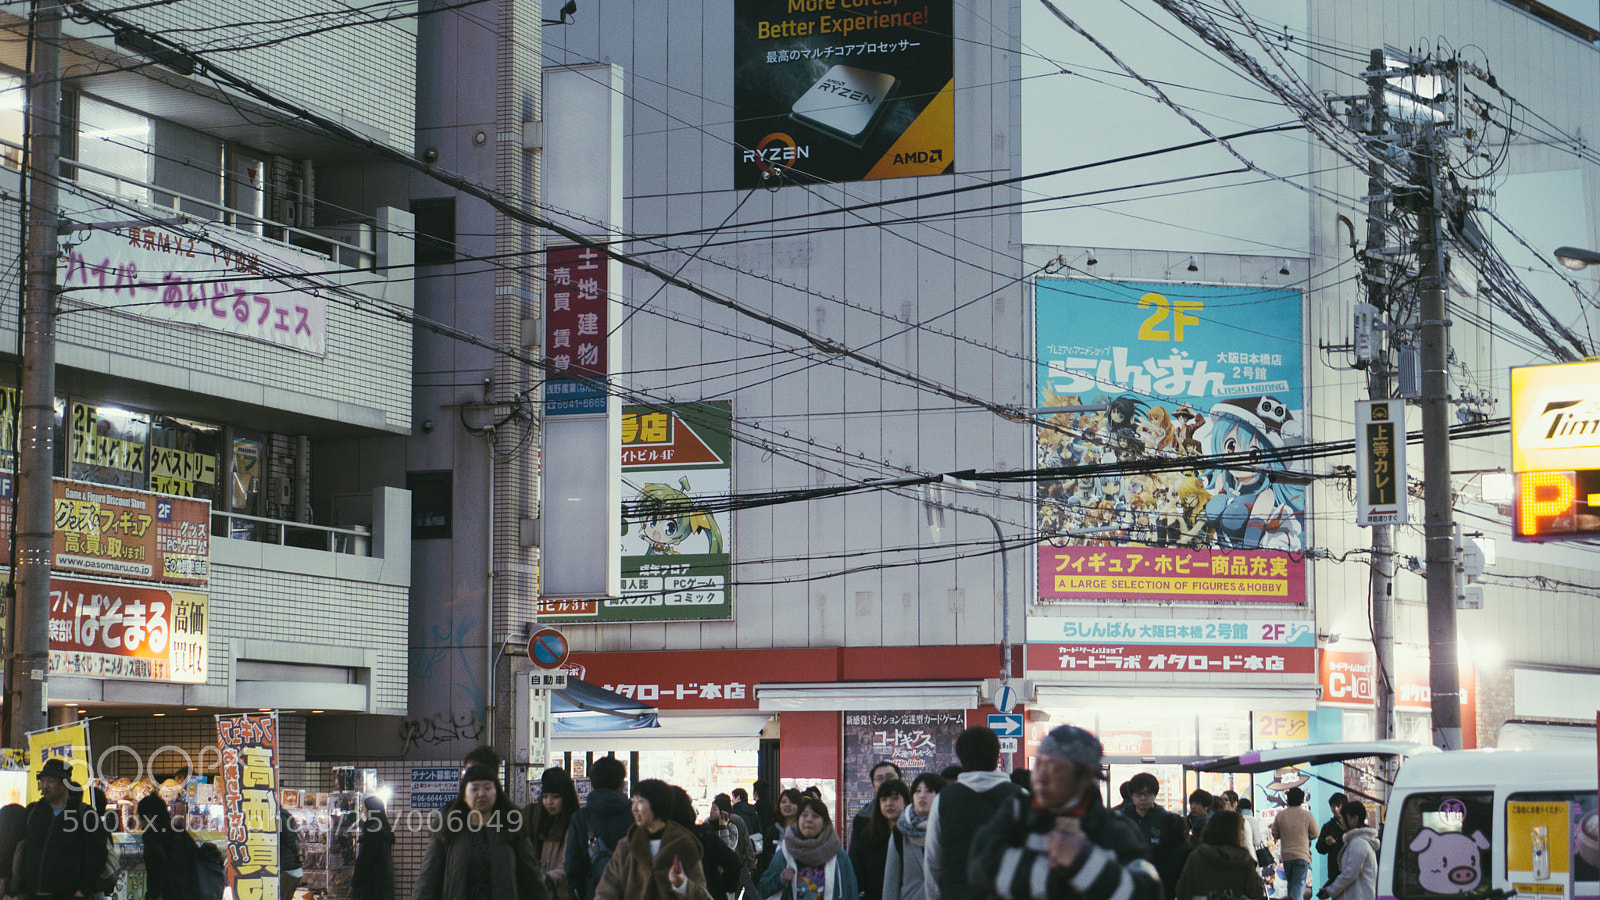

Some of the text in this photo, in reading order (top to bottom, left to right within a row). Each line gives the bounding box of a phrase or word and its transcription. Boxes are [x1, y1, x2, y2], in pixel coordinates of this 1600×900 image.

[788, 0, 835, 14] More
[758, 6, 928, 40] Better Experience!
[766, 39, 921, 64] 最高のマルチコアプロセッサー
[818, 82, 876, 104] RYZEN
[743, 145, 809, 163] RYZEN
[893, 151, 928, 165] AMD
[65, 250, 312, 337] ハイパーあいどるフェス
[553, 267, 571, 312] 売買
[578, 247, 599, 366] 土地建物
[1138, 293, 1203, 341] 2F
[1216, 351, 1282, 367] 大阪日本橋店
[1048, 347, 1226, 397] らしんばん
[1232, 367, 1267, 380] 2号館
[74, 404, 97, 434] 2F
[151, 446, 216, 484] タペストリー
[1372, 424, 1389, 504] 上等カレー
[65, 487, 81, 500] Game
[87, 492, 106, 505] Figure
[106, 494, 131, 508] Discount
[131, 499, 146, 510] Store
[1521, 472, 1574, 536] P
[158, 503, 171, 519] 2F
[180, 520, 207, 538] グッズ
[58, 556, 150, 576] www.pasomaru.co.jp
[1055, 552, 1288, 577] フィギュア・ホビー商品充実
[673, 578, 716, 588] PCゲーム
[1058, 579, 1067, 588] A
[1070, 579, 1107, 589] LARGE
[1111, 580, 1170, 590] SELECTION
[1174, 581, 1188, 590] OF
[674, 592, 715, 603] コミック
[75, 592, 169, 653] ぱそまる
[174, 600, 204, 635] 高価
[1063, 621, 1136, 639] らしんばん
[1261, 624, 1285, 641] 2F
[1058, 654, 1285, 671] カードラボ オタロード本店
[531, 674, 566, 685] 自動車
[1259, 715, 1288, 736] 2F
[872, 728, 936, 749] コードギアス
[412, 769, 459, 780] テナント募集中
